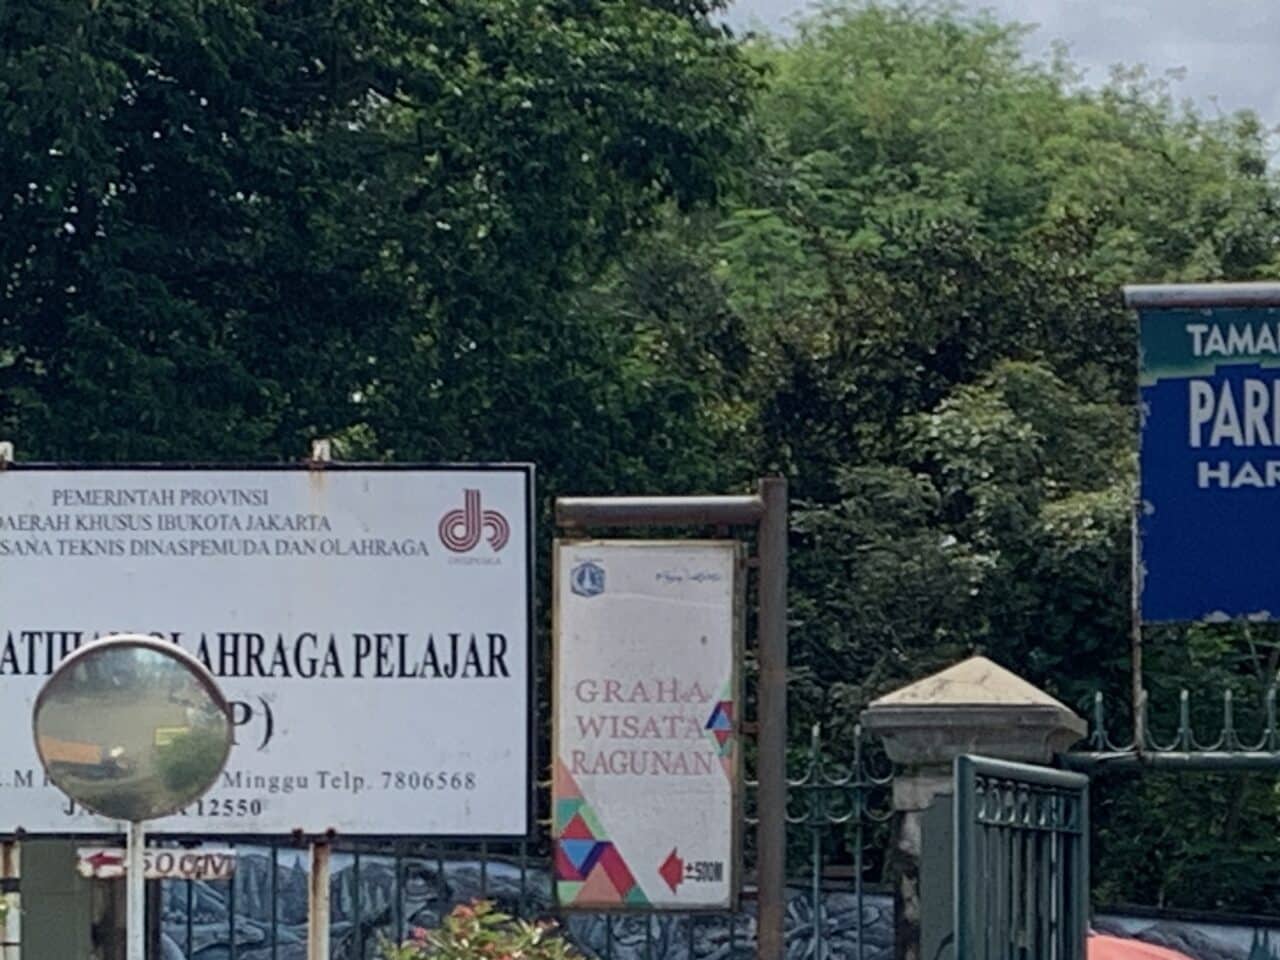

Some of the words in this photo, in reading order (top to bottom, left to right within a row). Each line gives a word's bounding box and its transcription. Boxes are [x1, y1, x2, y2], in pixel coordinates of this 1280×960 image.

[52, 489, 174, 506] PEMERINTAH
[180, 489, 269, 506] PROVINSI
[0, 514, 70, 531] AERAH
[75, 514, 153, 531] KHUSUS
[157, 514, 242, 531] IBUKOTA
[246, 514, 331, 531] JAKARTA
[57, 540, 125, 556] TEKNIS
[275, 539, 316, 556] DAN
[320, 539, 430, 556] OLAHRAGA
[353, 633, 510, 678] PELAJAR
[575, 679, 709, 703] GRAHA
[576, 715, 706, 739] WISATA
[572, 750, 714, 776] RAGUNAN
[223, 770, 308, 793] Minggu
[317, 770, 373, 792] Telp.
[381, 771, 477, 790] 7806568
